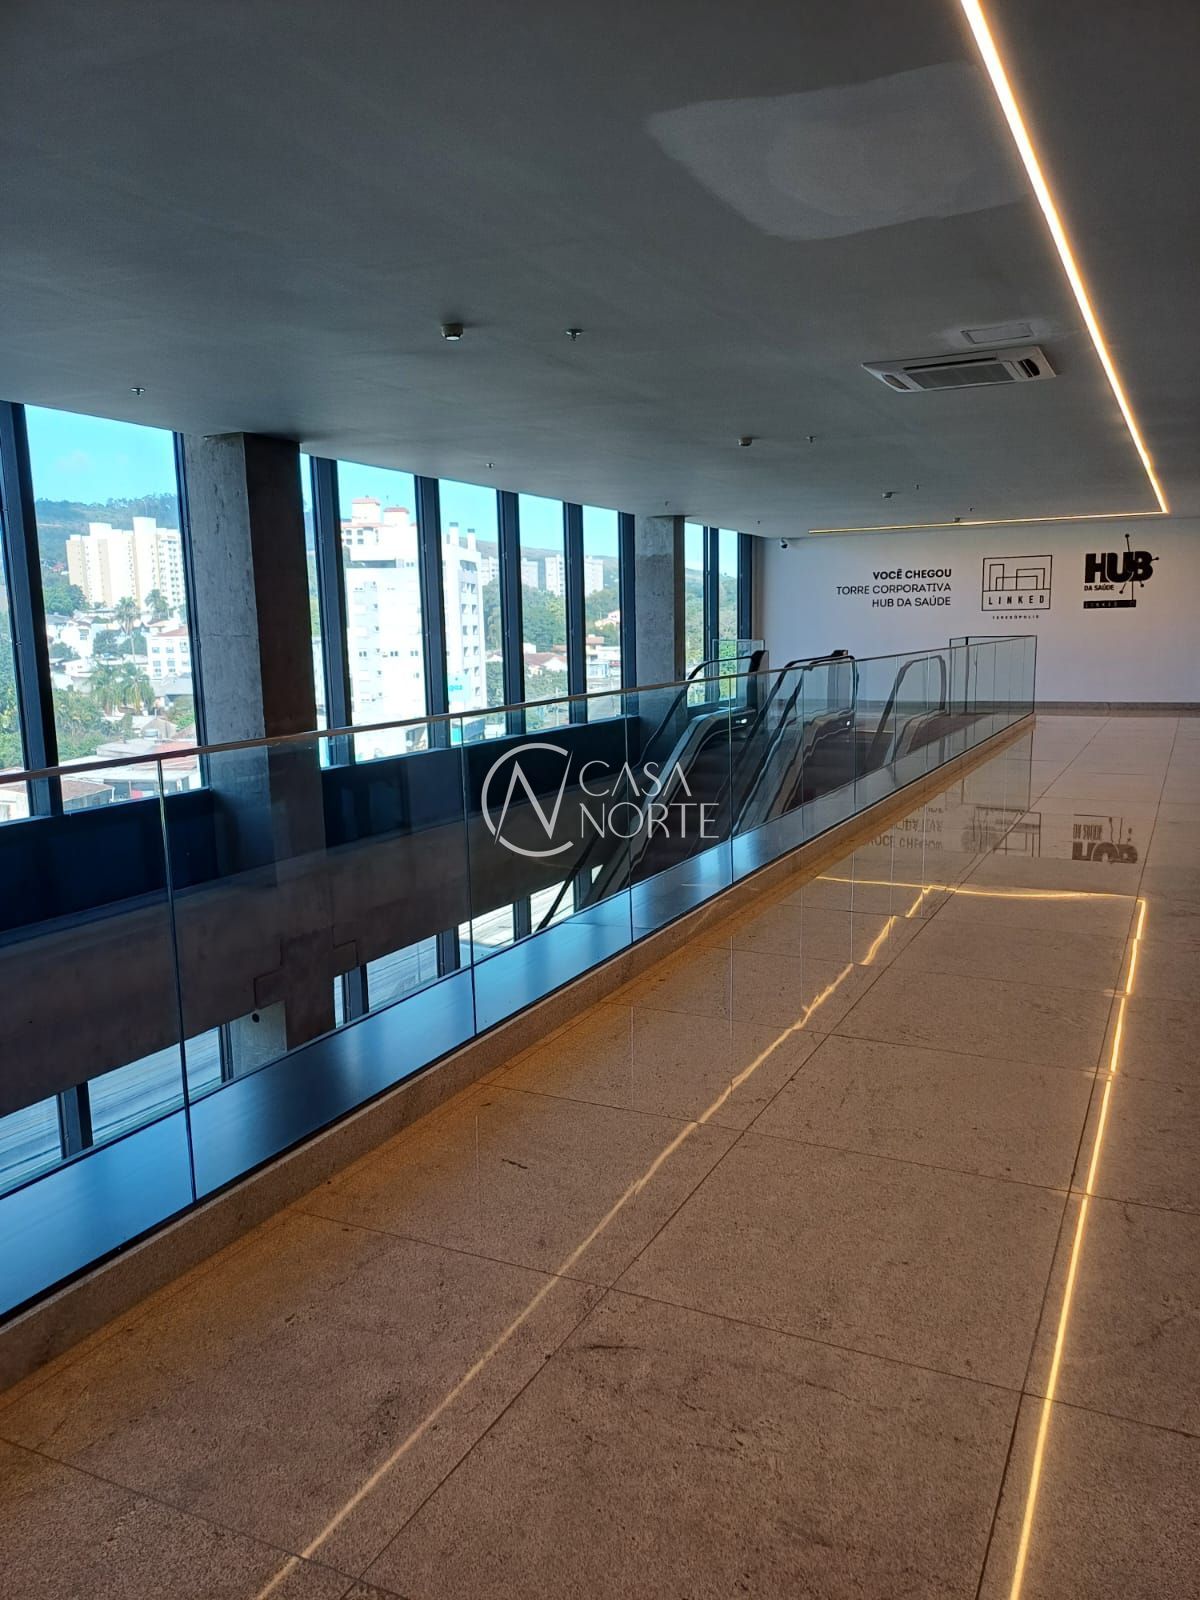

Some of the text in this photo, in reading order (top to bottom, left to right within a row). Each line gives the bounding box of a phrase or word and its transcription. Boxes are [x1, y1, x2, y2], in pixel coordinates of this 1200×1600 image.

[1084, 551, 1154, 583] HUB
[872, 568, 952, 580] VOCÊ CHEGOU
[836, 582, 952, 596] TORRE CORPORATIVA
[872, 595, 951, 608] HUB DA SAÚDE
[988, 595, 1045, 605] LINKED
